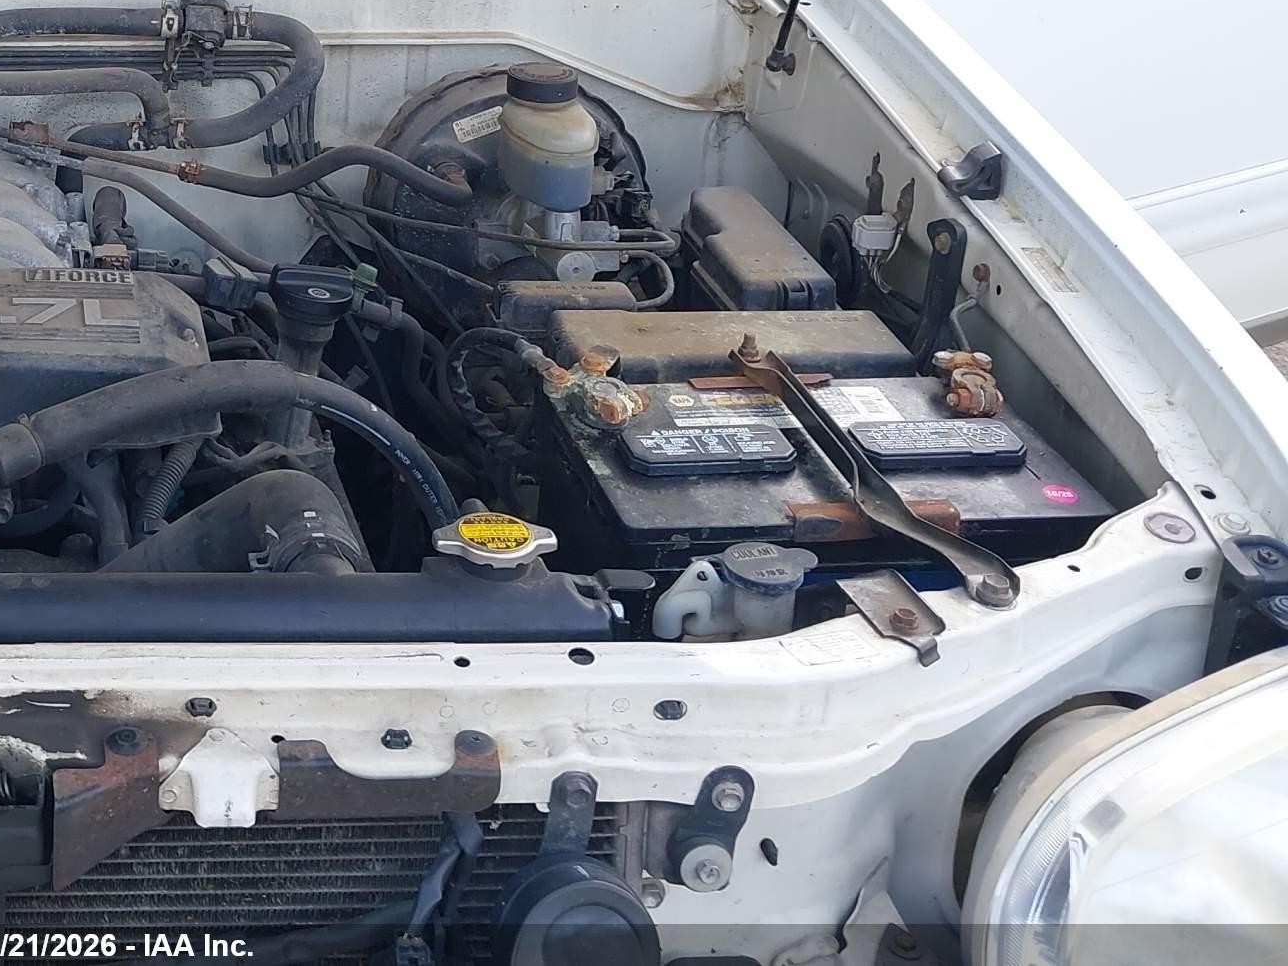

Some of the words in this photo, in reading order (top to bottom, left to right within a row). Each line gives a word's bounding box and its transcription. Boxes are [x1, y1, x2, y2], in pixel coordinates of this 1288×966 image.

[711, 427, 750, 435] POISON
[474, 536, 524, 545] CAUTION
[730, 546, 777, 560] COOLANT
